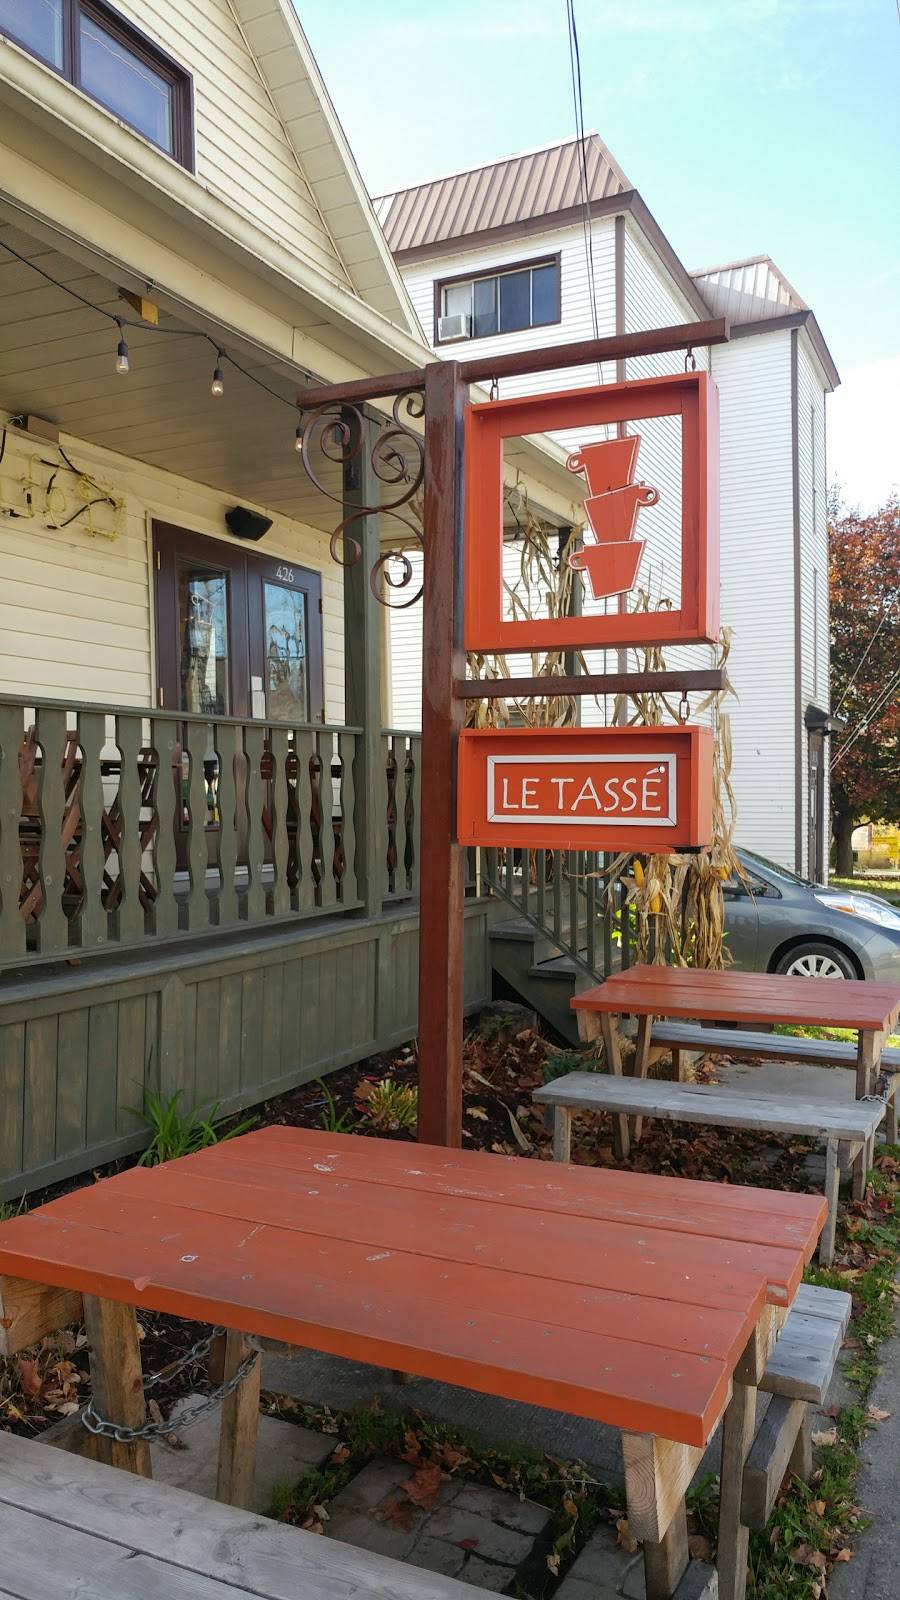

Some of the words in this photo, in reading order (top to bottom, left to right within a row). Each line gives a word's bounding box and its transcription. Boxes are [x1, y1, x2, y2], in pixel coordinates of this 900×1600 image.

[276, 565, 294, 583] 426
[502, 777, 540, 809] LE
[550, 765, 665, 812] TASSÉ
